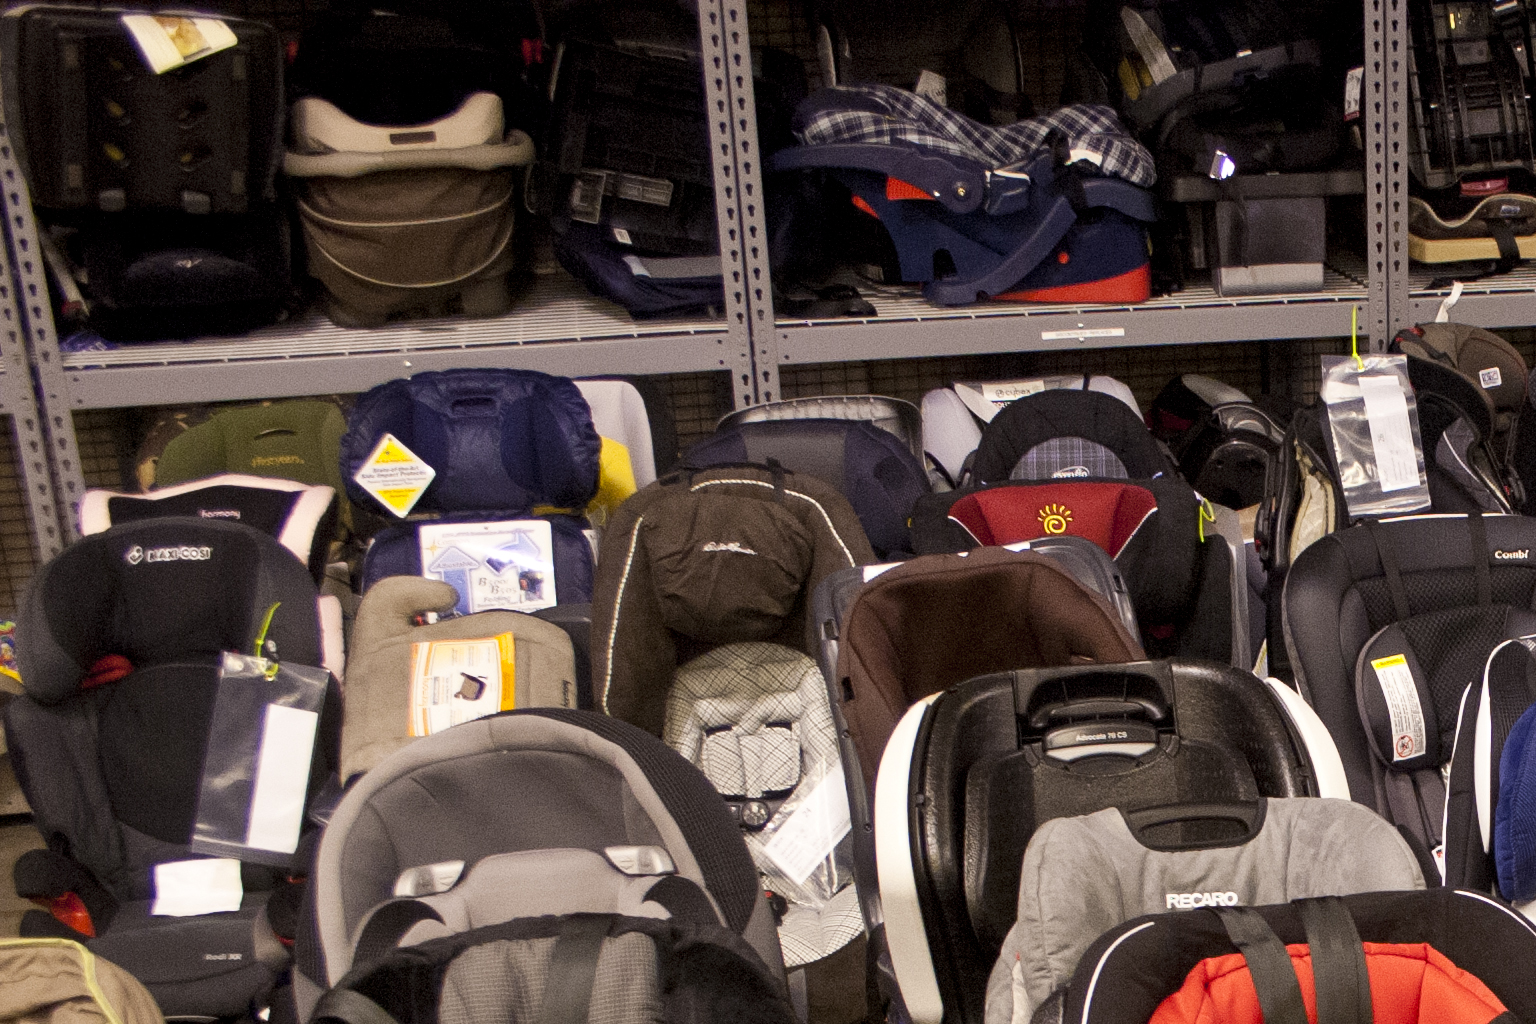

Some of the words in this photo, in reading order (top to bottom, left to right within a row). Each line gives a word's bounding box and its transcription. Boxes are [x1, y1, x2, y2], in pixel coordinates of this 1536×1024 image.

[147, 547, 211, 562] MAXI-COSI
[1494, 549, 1529, 559] Combi
[1166, 891, 1238, 908] RECARO
